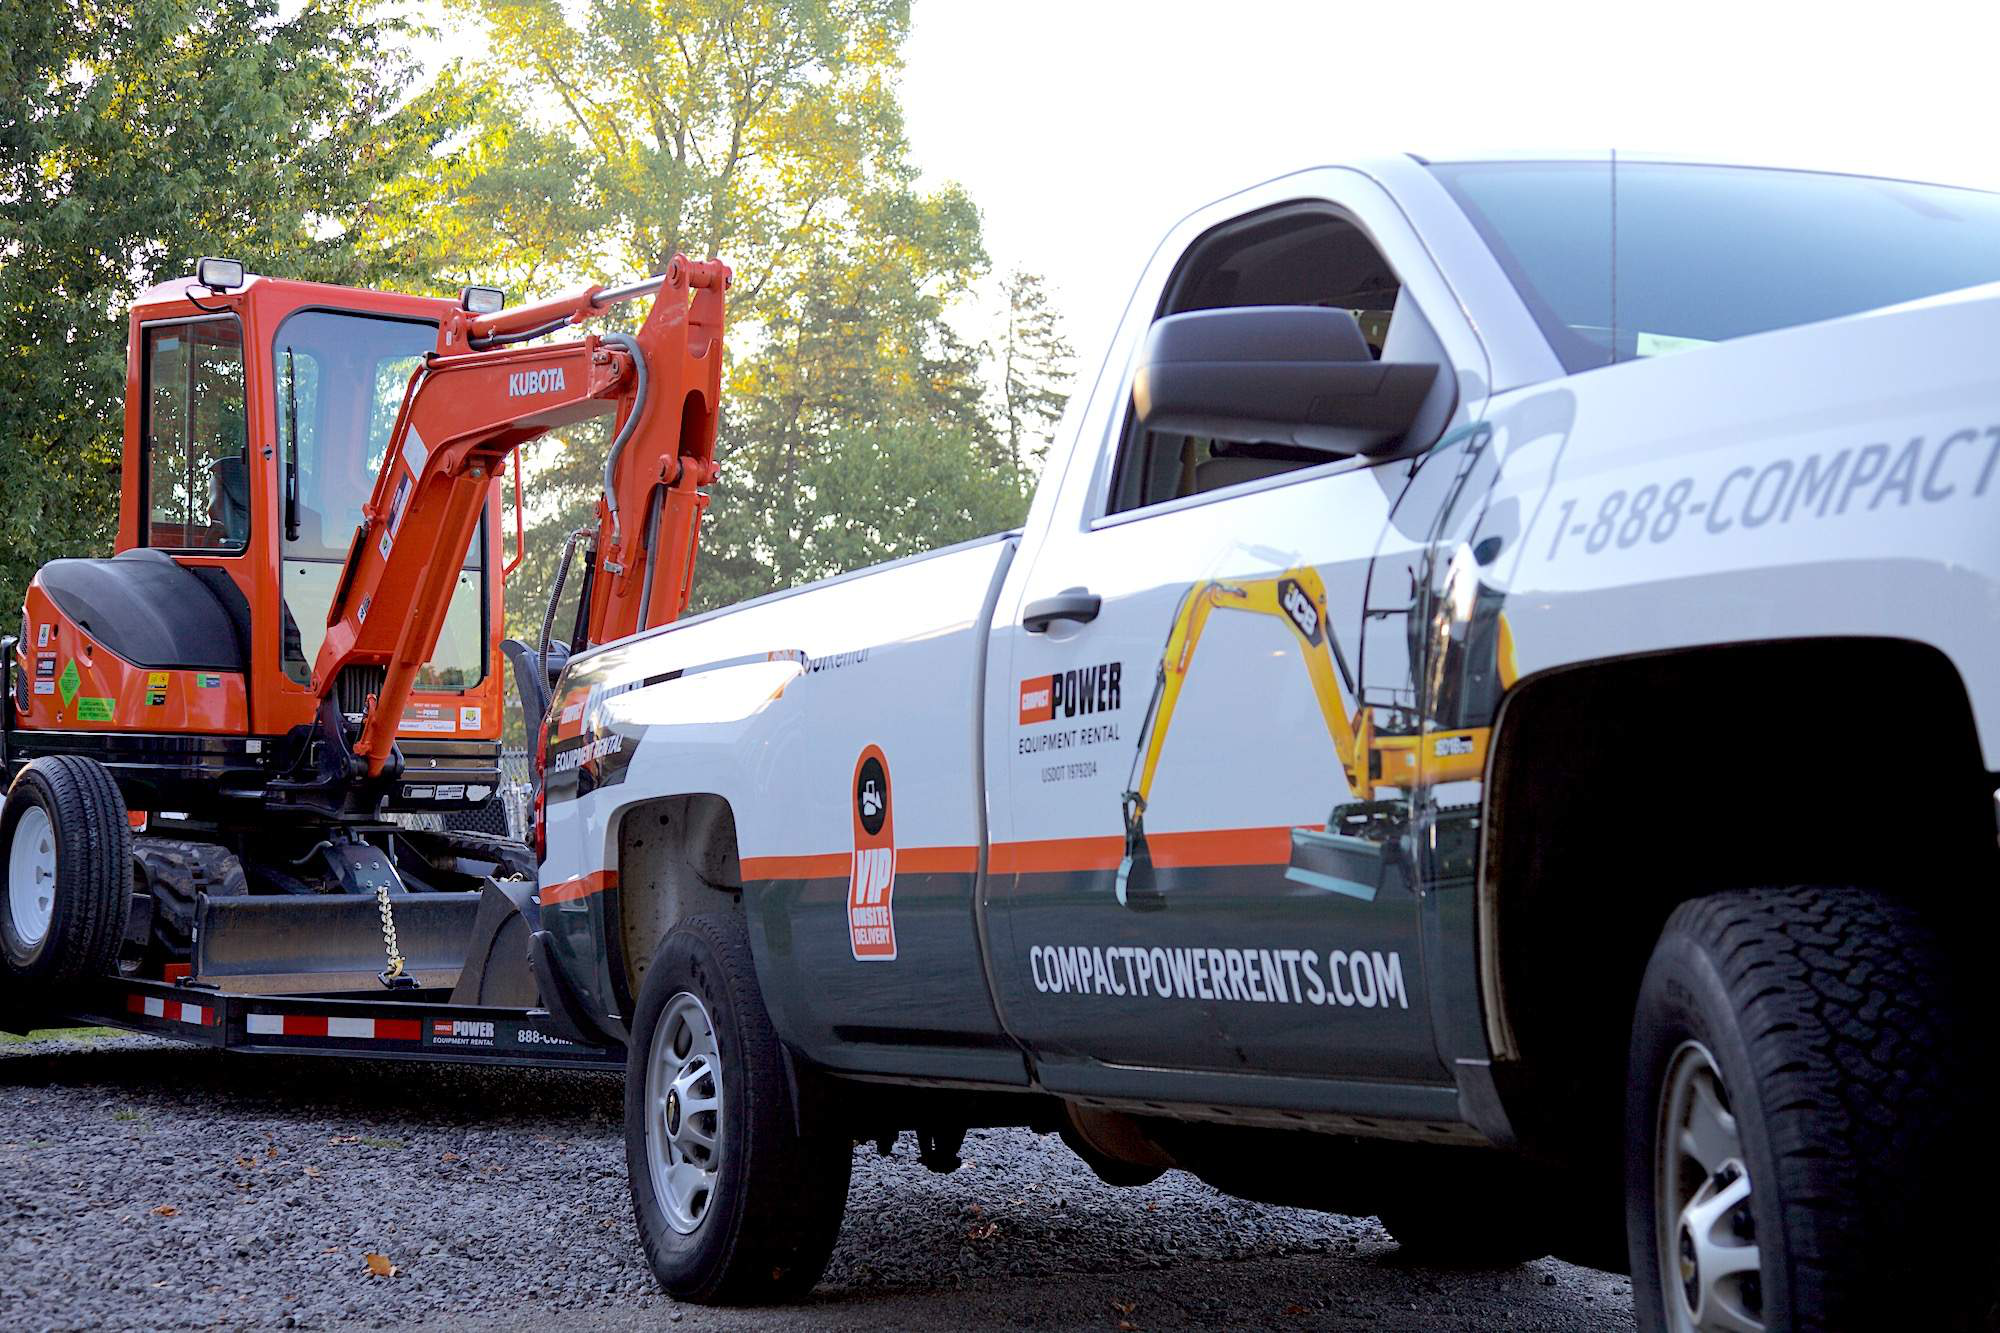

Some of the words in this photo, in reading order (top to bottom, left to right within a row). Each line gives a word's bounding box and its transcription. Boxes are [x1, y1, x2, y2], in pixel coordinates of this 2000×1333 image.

[509, 367, 566, 397] KUBOTA
[1284, 588, 1318, 636] JCB
[1051, 662, 1121, 719] POWER
[555, 743, 595, 773] EQUIPMENT
[594, 734, 624, 760] RENTAL
[1019, 731, 1076, 754] EQUIPMENT
[1080, 724, 1120, 745] RENTAL
[1041, 765, 1065, 783] USDOT
[856, 848, 892, 905] VIP
[853, 906, 889, 927] ONSITE
[855, 927, 890, 945] DELIVERY
[1030, 945, 1409, 1009] COMPACTPOWERRENTS.COM
[432, 1037, 470, 1045] EQUIPMENT
[470, 1038, 494, 1047] RENTAL
[452, 1021, 495, 1038] POWER
